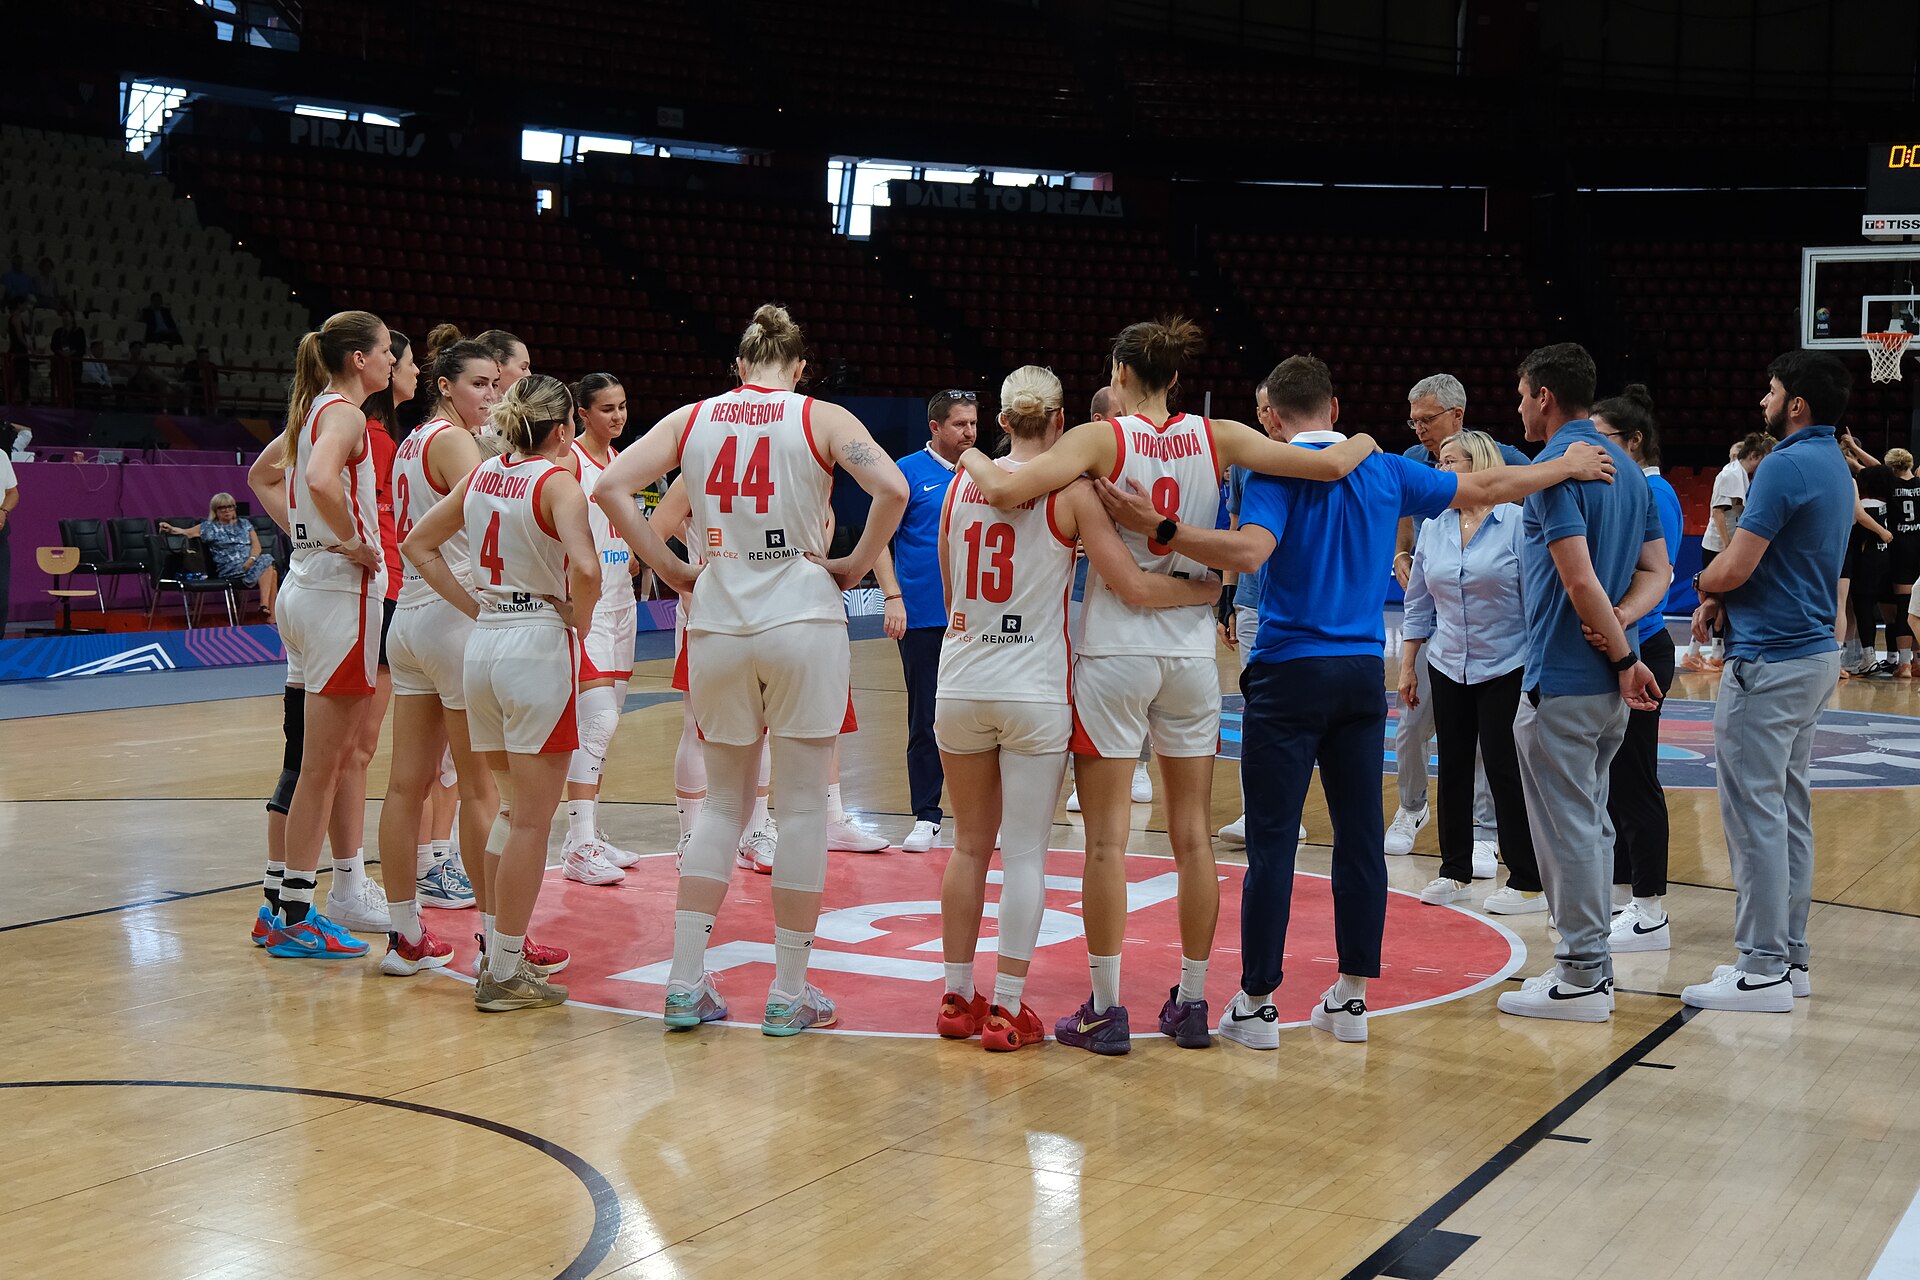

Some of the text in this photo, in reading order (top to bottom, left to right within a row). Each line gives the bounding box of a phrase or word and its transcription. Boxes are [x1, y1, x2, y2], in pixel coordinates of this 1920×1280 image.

[290, 116, 426, 158] PIRAEUS
[905, 182, 1125, 218] DARE TO DREAM
[710, 399, 786, 426] REISINGEROVÁ
[705, 435, 775, 514] 44
[1903, 500, 1915, 522] 9
[480, 510, 505, 586] 4
[748, 547, 800, 561] RENOMIA
[964, 521, 1016, 604] 13
[981, 634, 1034, 645] RENOMIA
